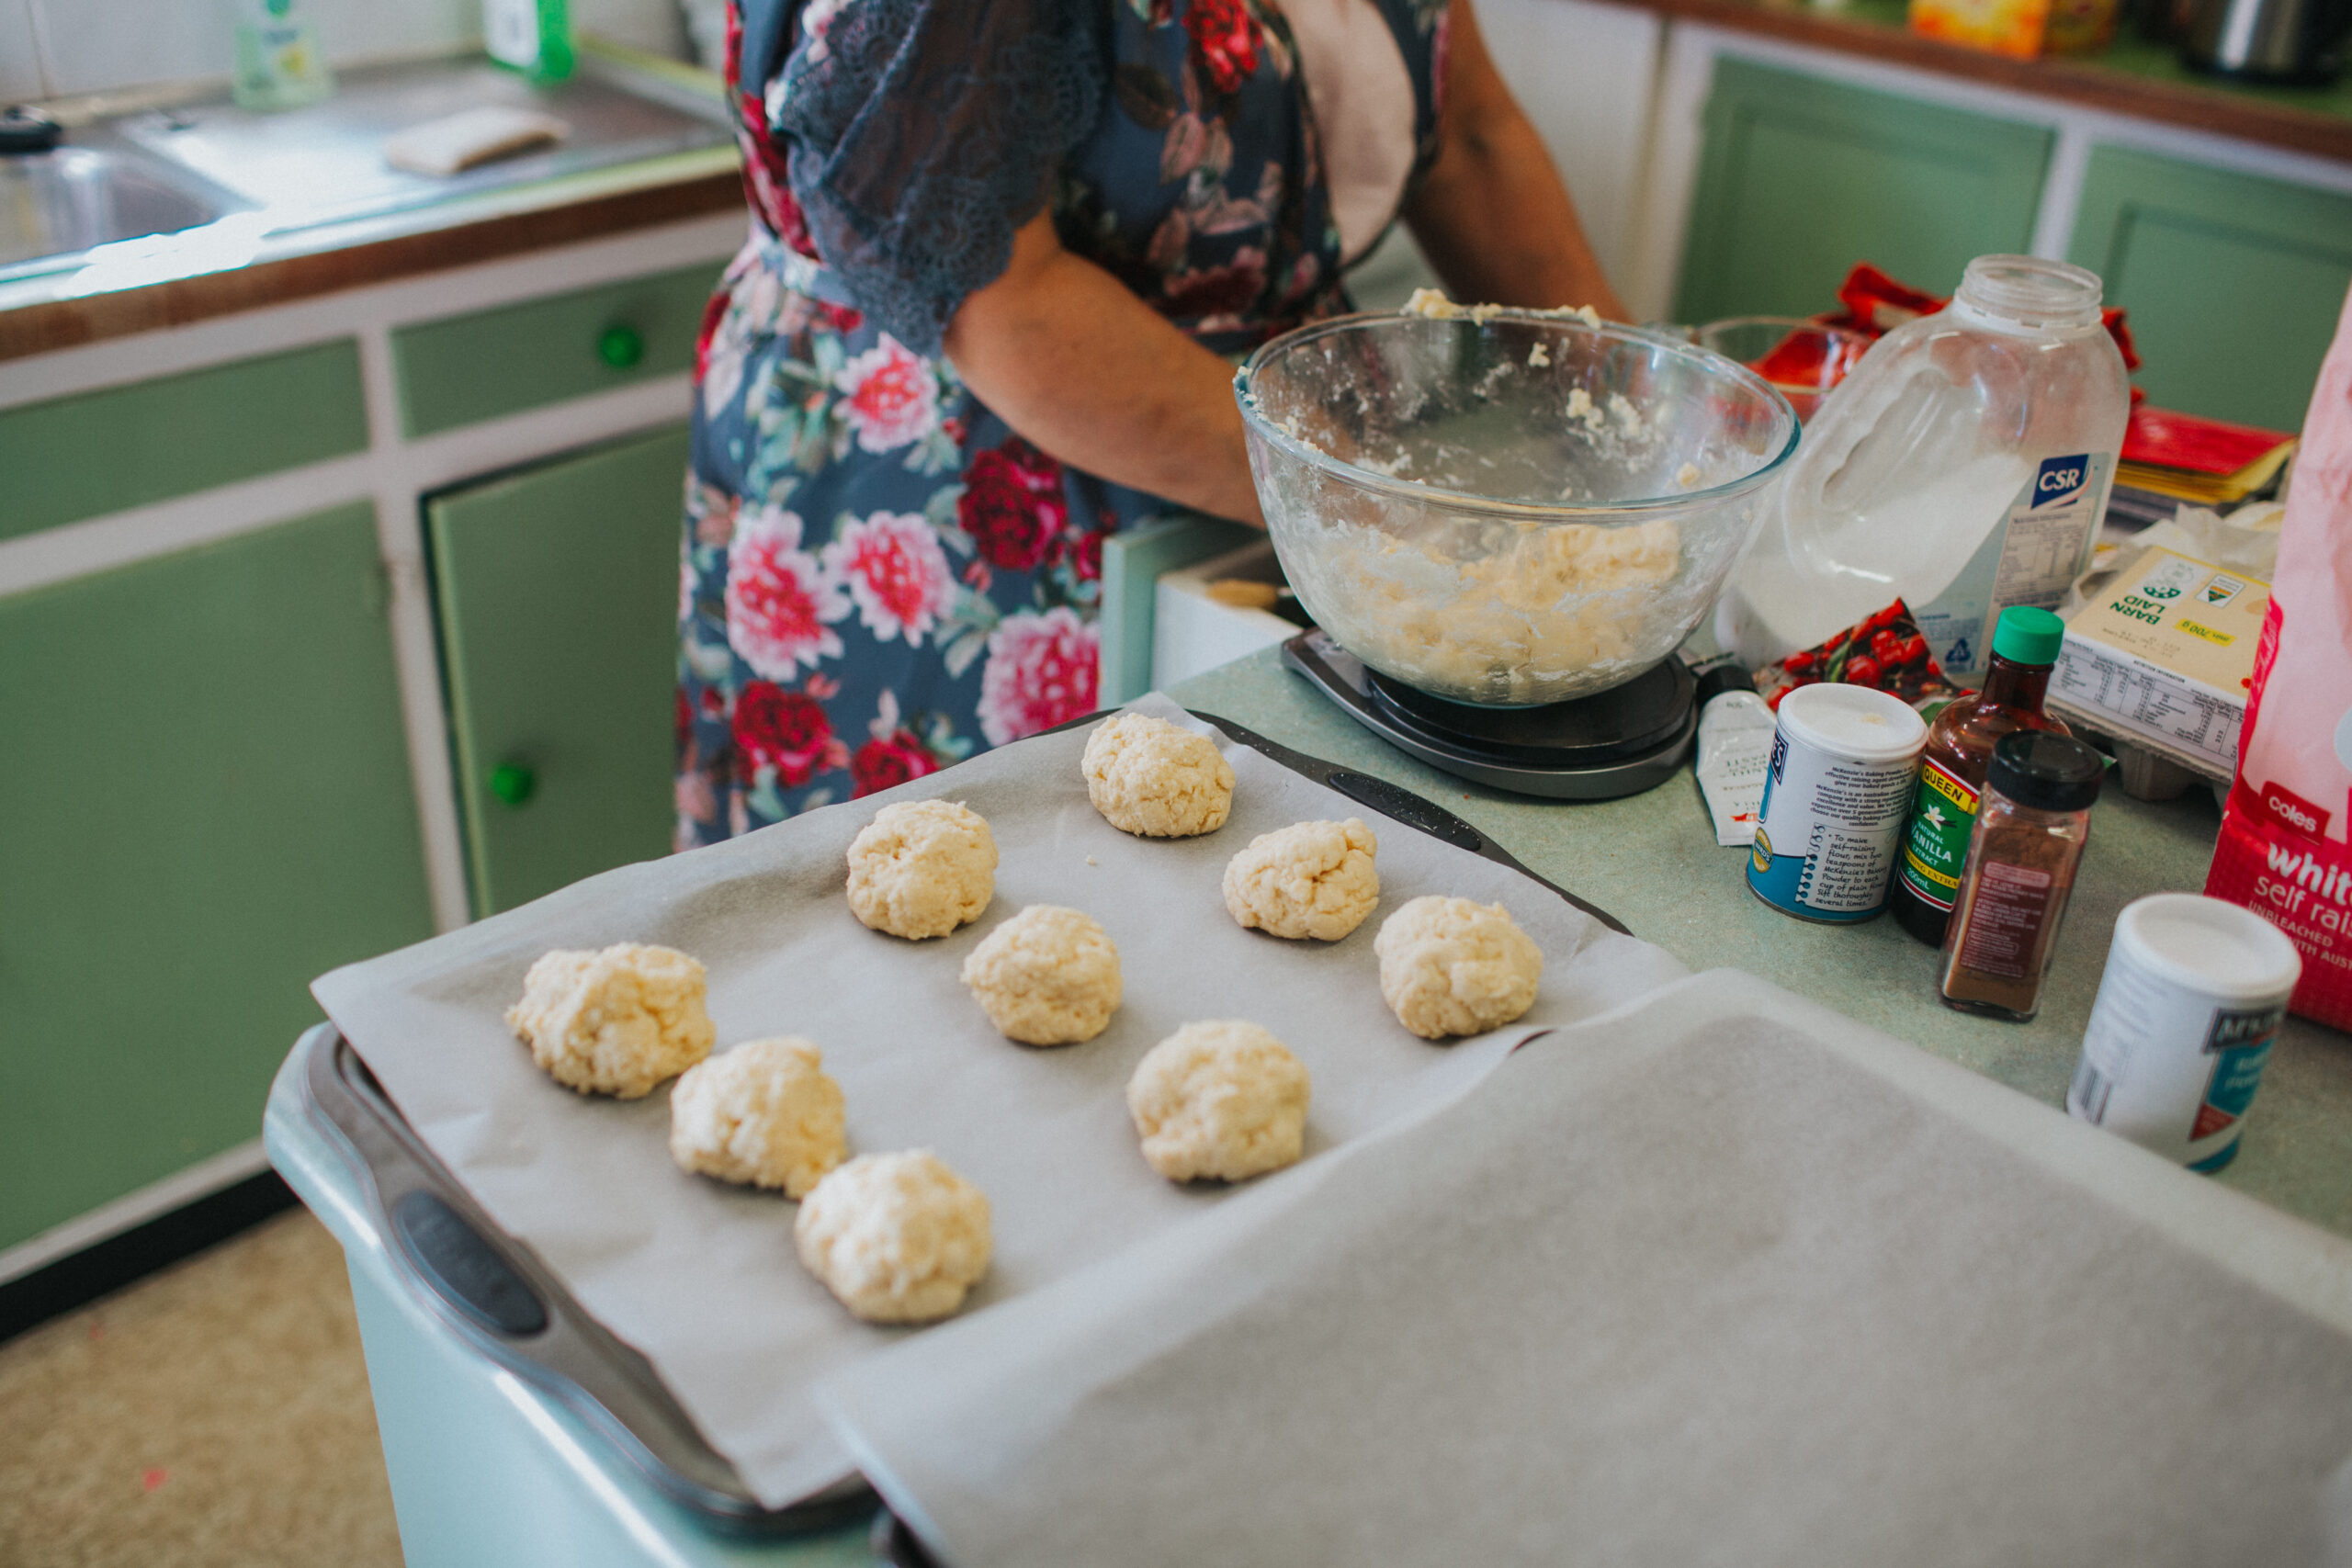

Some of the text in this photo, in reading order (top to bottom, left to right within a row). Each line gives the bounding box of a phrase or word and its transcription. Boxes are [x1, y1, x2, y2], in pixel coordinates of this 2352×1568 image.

[2039, 468, 2080, 492] CSR
[2123, 595, 2166, 615] LAID
[2109, 602, 2161, 625] BARN
[2182, 620, 2190, 628] g
[2189, 625, 2211, 637] 700
[1825, 771, 1850, 781] effective
[1832, 766, 1863, 776] McKenzie's
[1815, 784, 1847, 795] McKenzie's
[1925, 768, 1963, 802] QUEEN
[1816, 797, 1846, 807] excellence
[1817, 791, 1843, 802] company
[1809, 807, 1830, 817] choose
[1811, 801, 1838, 812] expertise
[2268, 795, 2317, 833] coles
[1917, 820, 1944, 845] NATURAL
[1830, 842, 1876, 852] self-raising
[1911, 823, 1951, 863] VANILLA
[1827, 848, 1850, 860] flour,
[1870, 851, 1883, 859] two
[1912, 843, 1939, 866] EXTRACT
[1826, 855, 1877, 869] teaspoons of
[1824, 865, 1865, 875] McKenzie's
[2267, 841, 2352, 906] whit
[1822, 873, 1851, 883] Powder
[1864, 874, 1879, 883] each
[1907, 866, 1934, 889] 200mL
[1819, 882, 1835, 890] cup
[1837, 884, 1847, 892] of
[1849, 885, 1867, 894] plain
[2254, 875, 2307, 913] self
[1817, 888, 1874, 901] Sift thoroughly
[1815, 897, 1843, 907] several
[2248, 900, 2334, 947] UNBLEACHED
